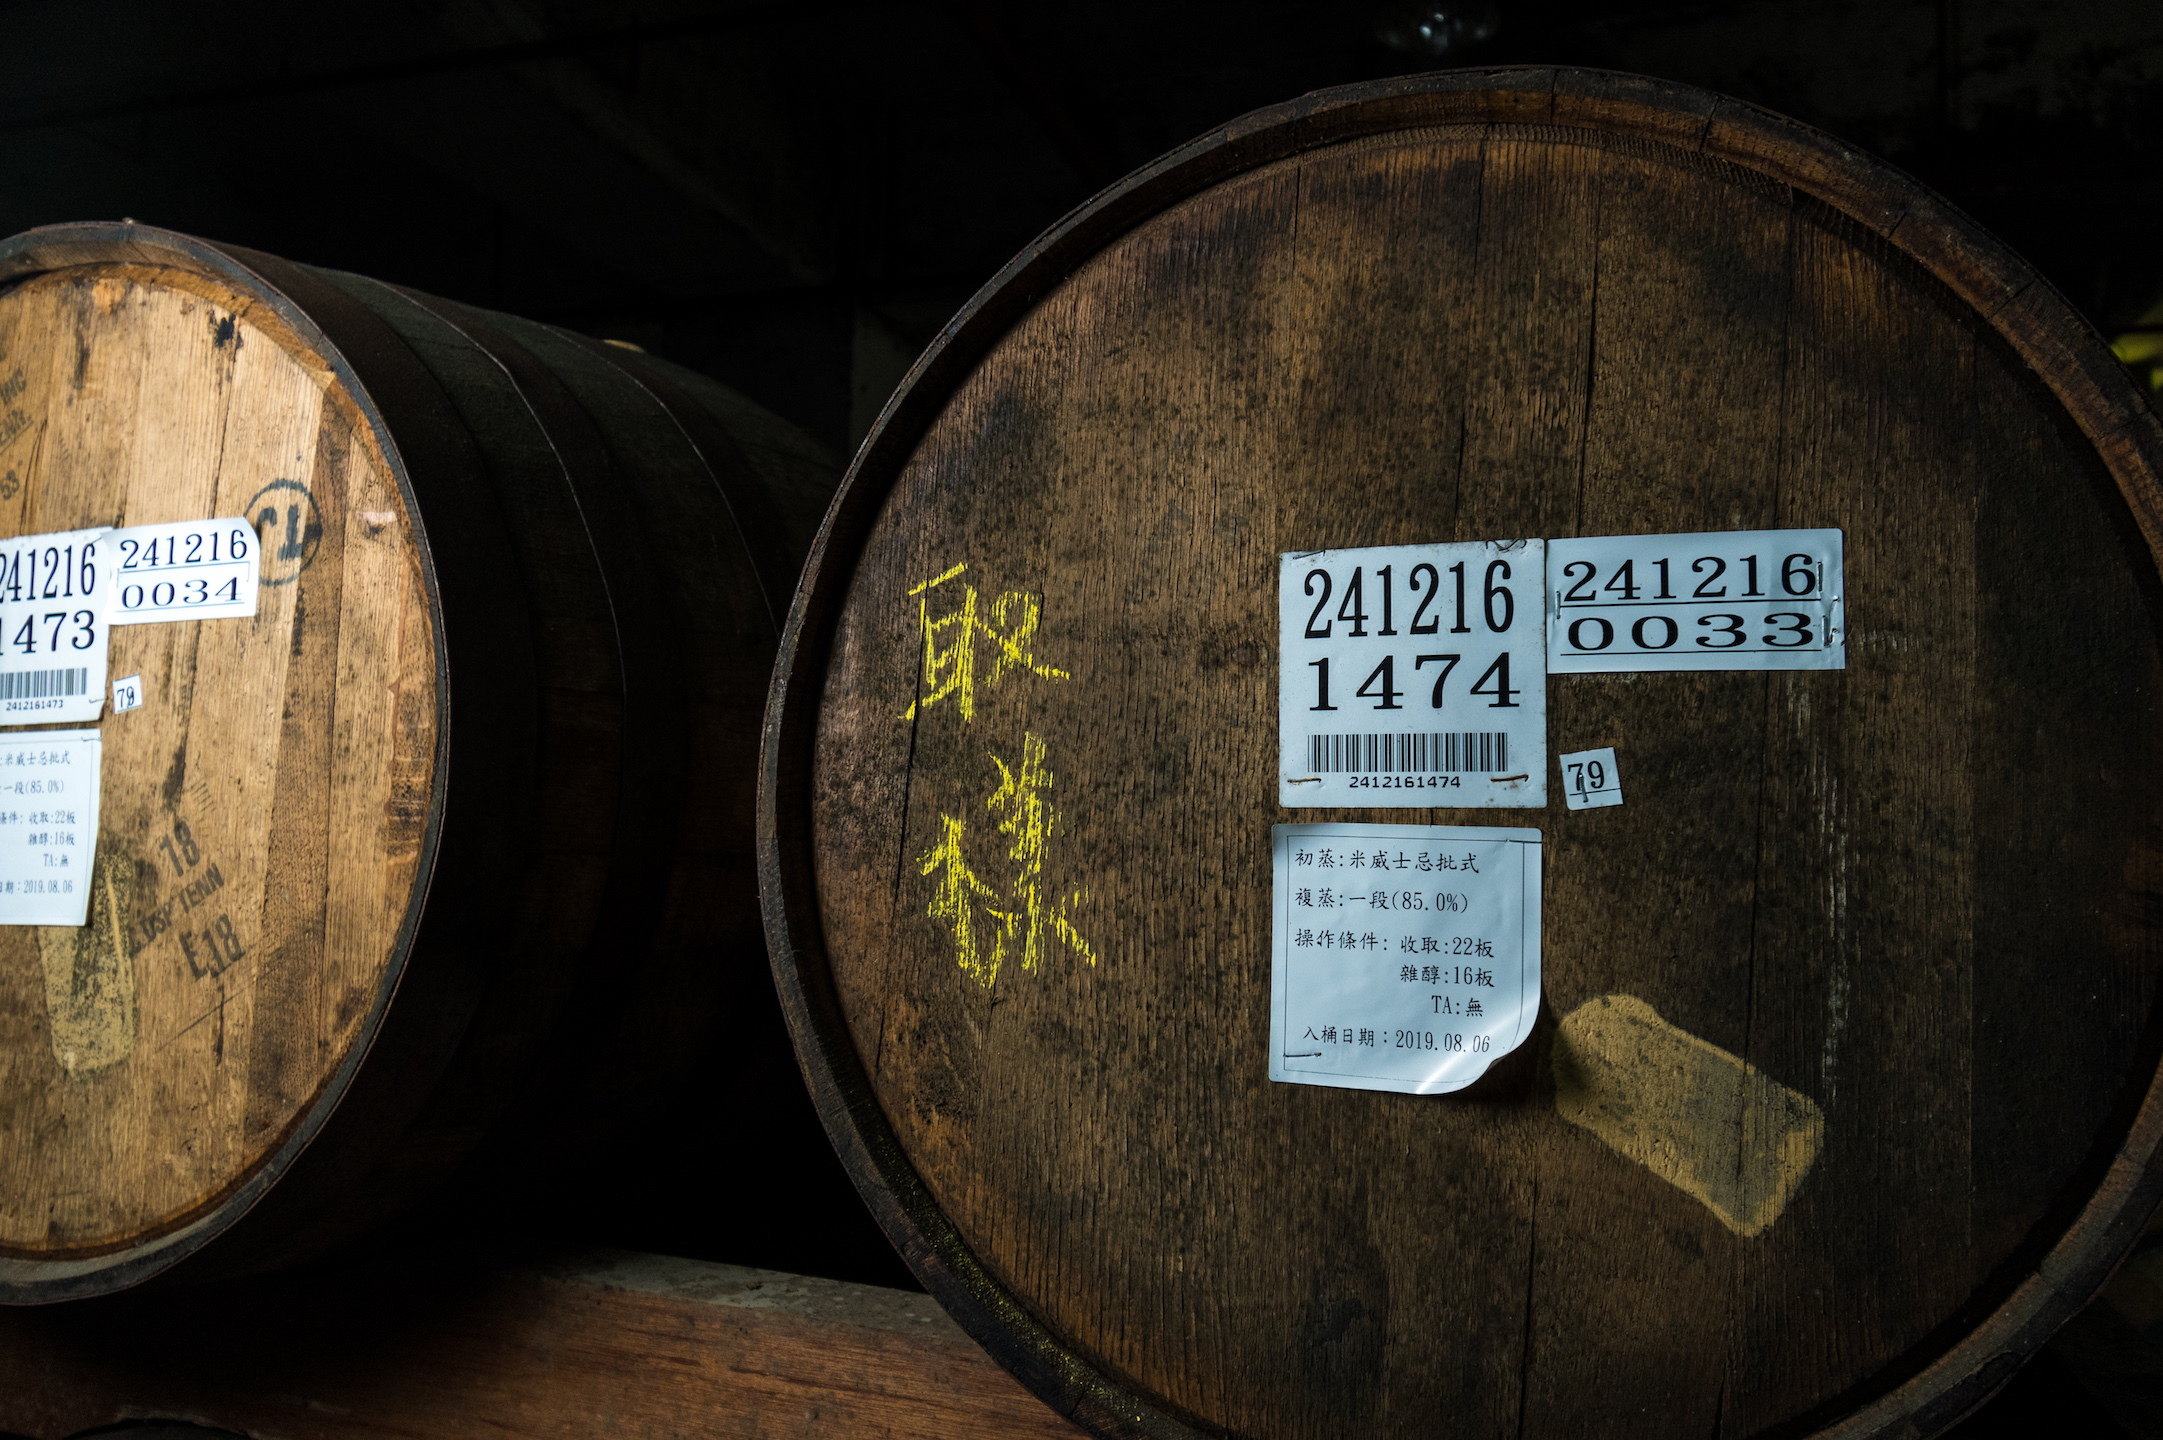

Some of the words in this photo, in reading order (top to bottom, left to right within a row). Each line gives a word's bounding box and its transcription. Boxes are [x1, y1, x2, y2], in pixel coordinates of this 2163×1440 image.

[120, 529, 247, 569] 241216
[122, 577, 242, 609] 0034
[1563, 553, 1816, 601] 241216
[1304, 559, 1514, 638] 241216
[0, 610, 95, 656] 473
[1568, 612, 1814, 651] 0033
[1308, 652, 1521, 711] 1474
[6, 699, 64, 711] 2412161473
[0, 780, 64, 795] 一段(85.0%)
[1349, 776, 1461, 788] 2412161474
[1567, 760, 1605, 791] 79
[159, 820, 200, 877] 18
[1295, 848, 1480, 874] 初蒸:米威士忌批式
[1431, 995, 1484, 1017] TA:無
